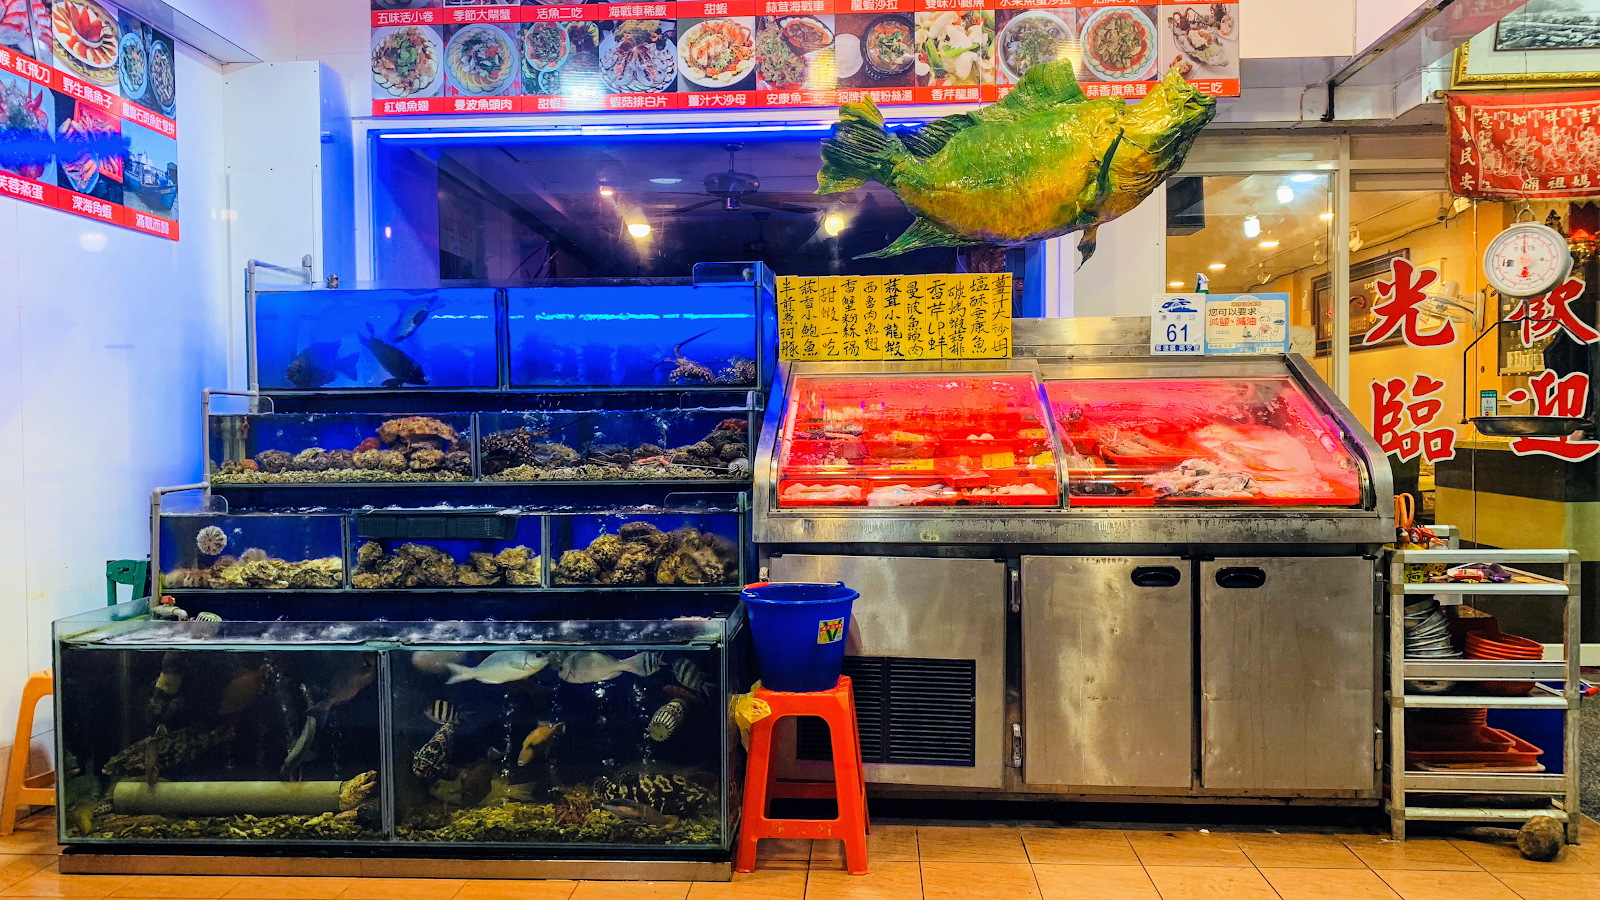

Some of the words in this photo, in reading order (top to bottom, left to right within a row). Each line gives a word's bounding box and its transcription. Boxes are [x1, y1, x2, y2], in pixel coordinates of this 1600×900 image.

[608, 5, 667, 18] 海戰車稀飯
[704, 3, 728, 15] 甜蝦
[765, 1, 825, 13] 蒜茸海戰車
[851, 0, 898, 11] 龍蝦沙拉
[377, 11, 433, 24] 五味活小卷
[453, 9, 511, 21] 季節大閘蟹
[536, 7, 583, 19] 活魚二吃
[931, 88, 979, 100] 香芹龍腸
[1086, 84, 1147, 96] 蒜香旗魚蛋
[454, 99, 512, 111] 曼波魚頭肉
[688, 94, 746, 106] 薑汁大沙母
[384, 100, 429, 113] 紅燒魚翅
[71, 194, 113, 220] 深海角蝦
[135, 213, 170, 235] 滿載而歸
[799, 279, 820, 356] 蒜香小鮑魚
[883, 278, 905, 357] 蒜茸小龍蝦
[1209, 307, 1257, 317] 您可以要求
[820, 286, 840, 356] 甜蝦二吃
[1167, 323, 1188, 342] 61
[1362, 257, 1458, 465] 光臨
